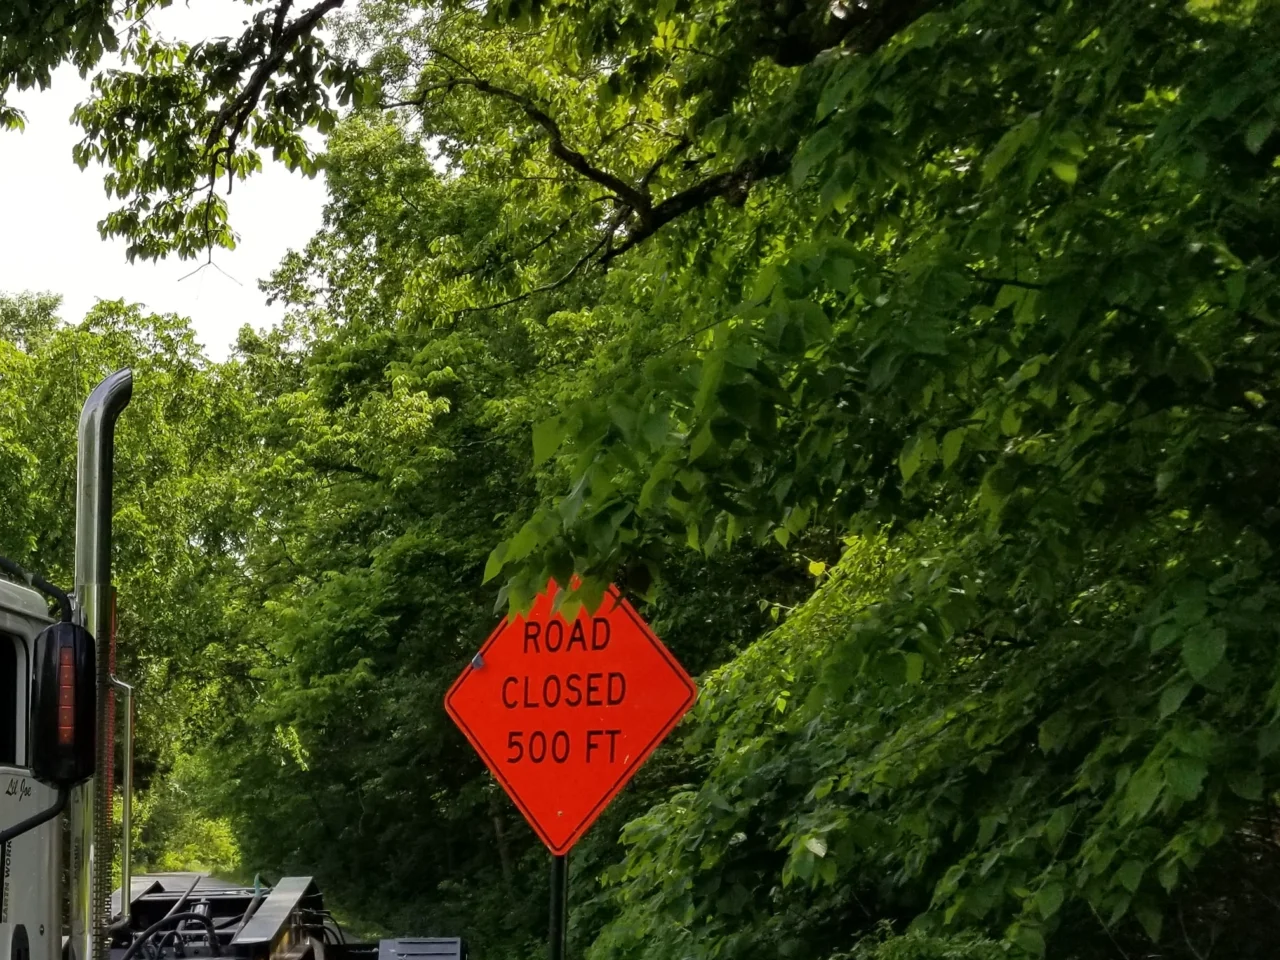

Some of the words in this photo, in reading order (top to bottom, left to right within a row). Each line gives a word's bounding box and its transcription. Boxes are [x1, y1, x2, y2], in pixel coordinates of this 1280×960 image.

[523, 617, 611, 653] ROAD
[501, 672, 627, 708] CLOSED
[506, 730, 570, 763] 500
[585, 729, 622, 763] FT
[18, 778, 31, 802] Joe
[2, 882, 10, 924] EARTH
